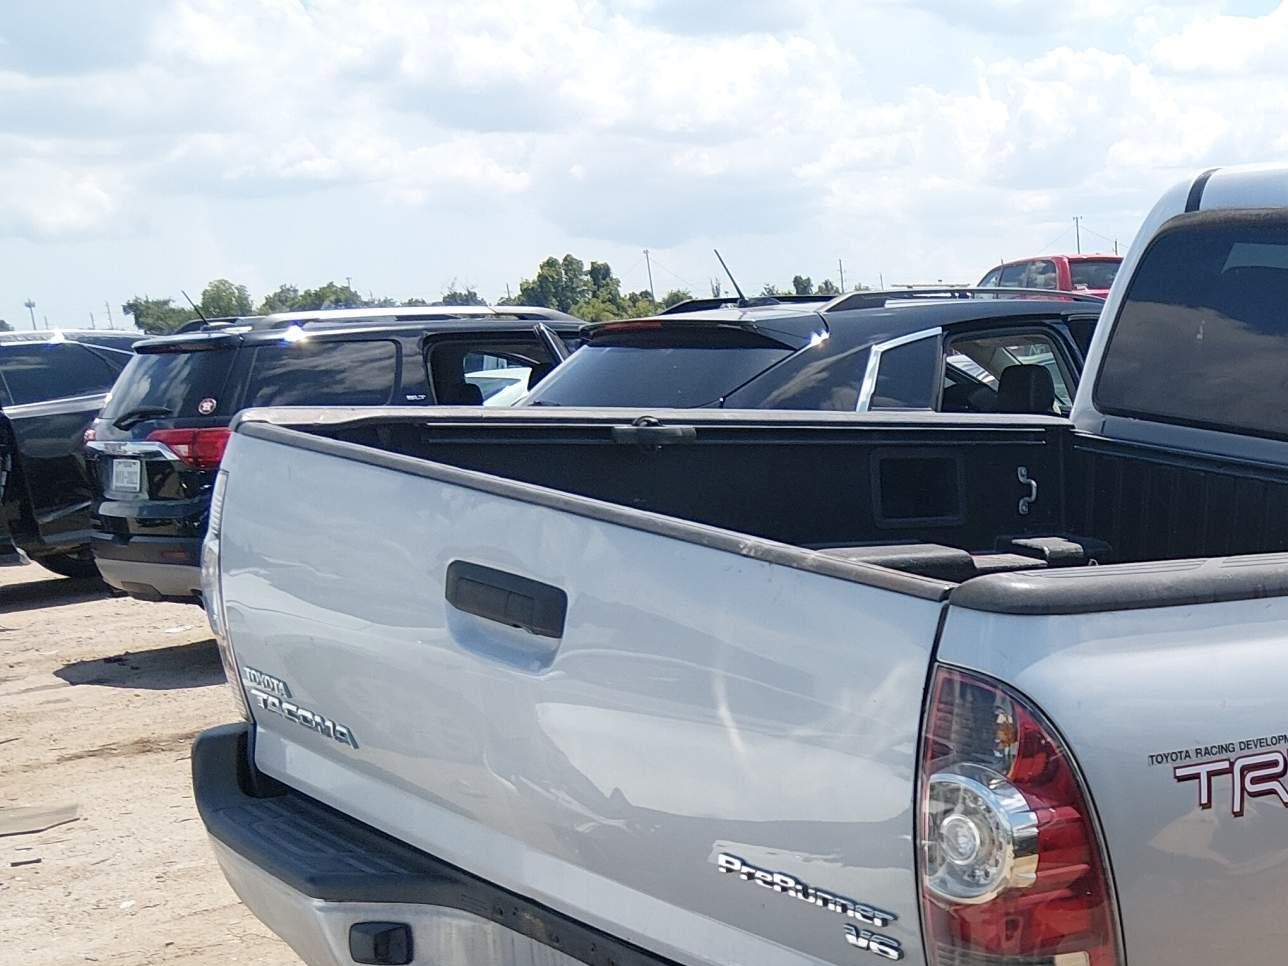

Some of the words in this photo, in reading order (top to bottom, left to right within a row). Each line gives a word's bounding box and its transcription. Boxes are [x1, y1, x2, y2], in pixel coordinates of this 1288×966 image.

[243, 666, 292, 699] TOYOTA
[250, 688, 359, 749] TACOMA
[1148, 749, 1192, 766] TOYOTA
[1195, 742, 1236, 759] RACING
[717, 852, 898, 927] PreRunner
[843, 922, 904, 961] V6
